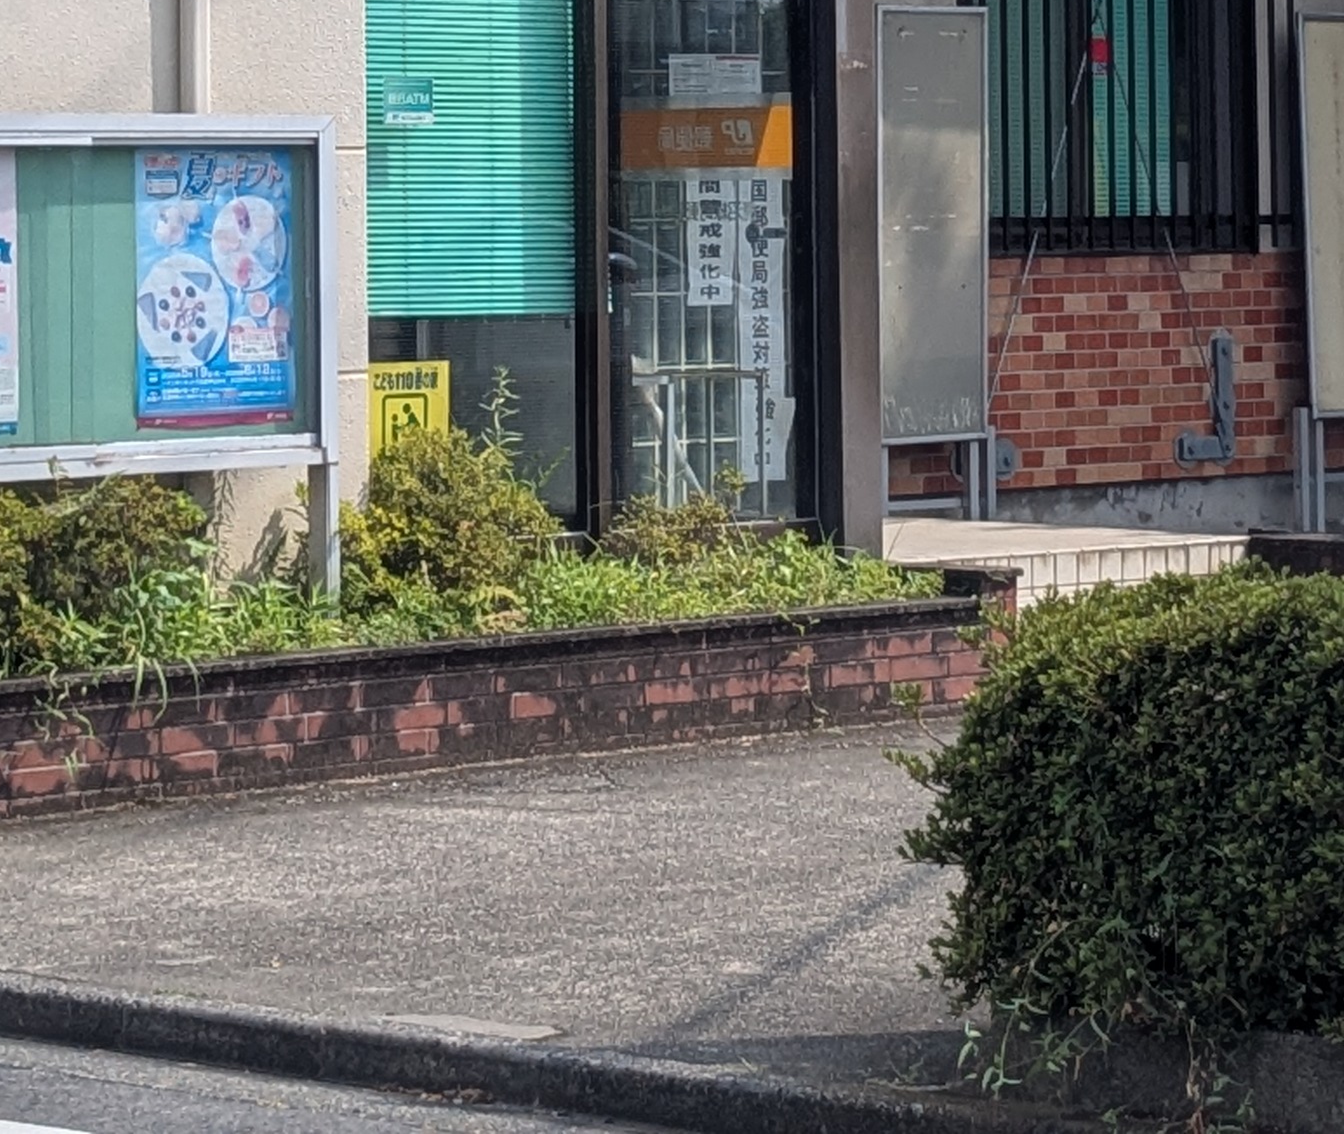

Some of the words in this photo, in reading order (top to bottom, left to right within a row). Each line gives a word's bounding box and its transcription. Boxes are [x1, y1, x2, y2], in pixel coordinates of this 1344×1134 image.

[181, 151, 283, 202] 夏のギフト
